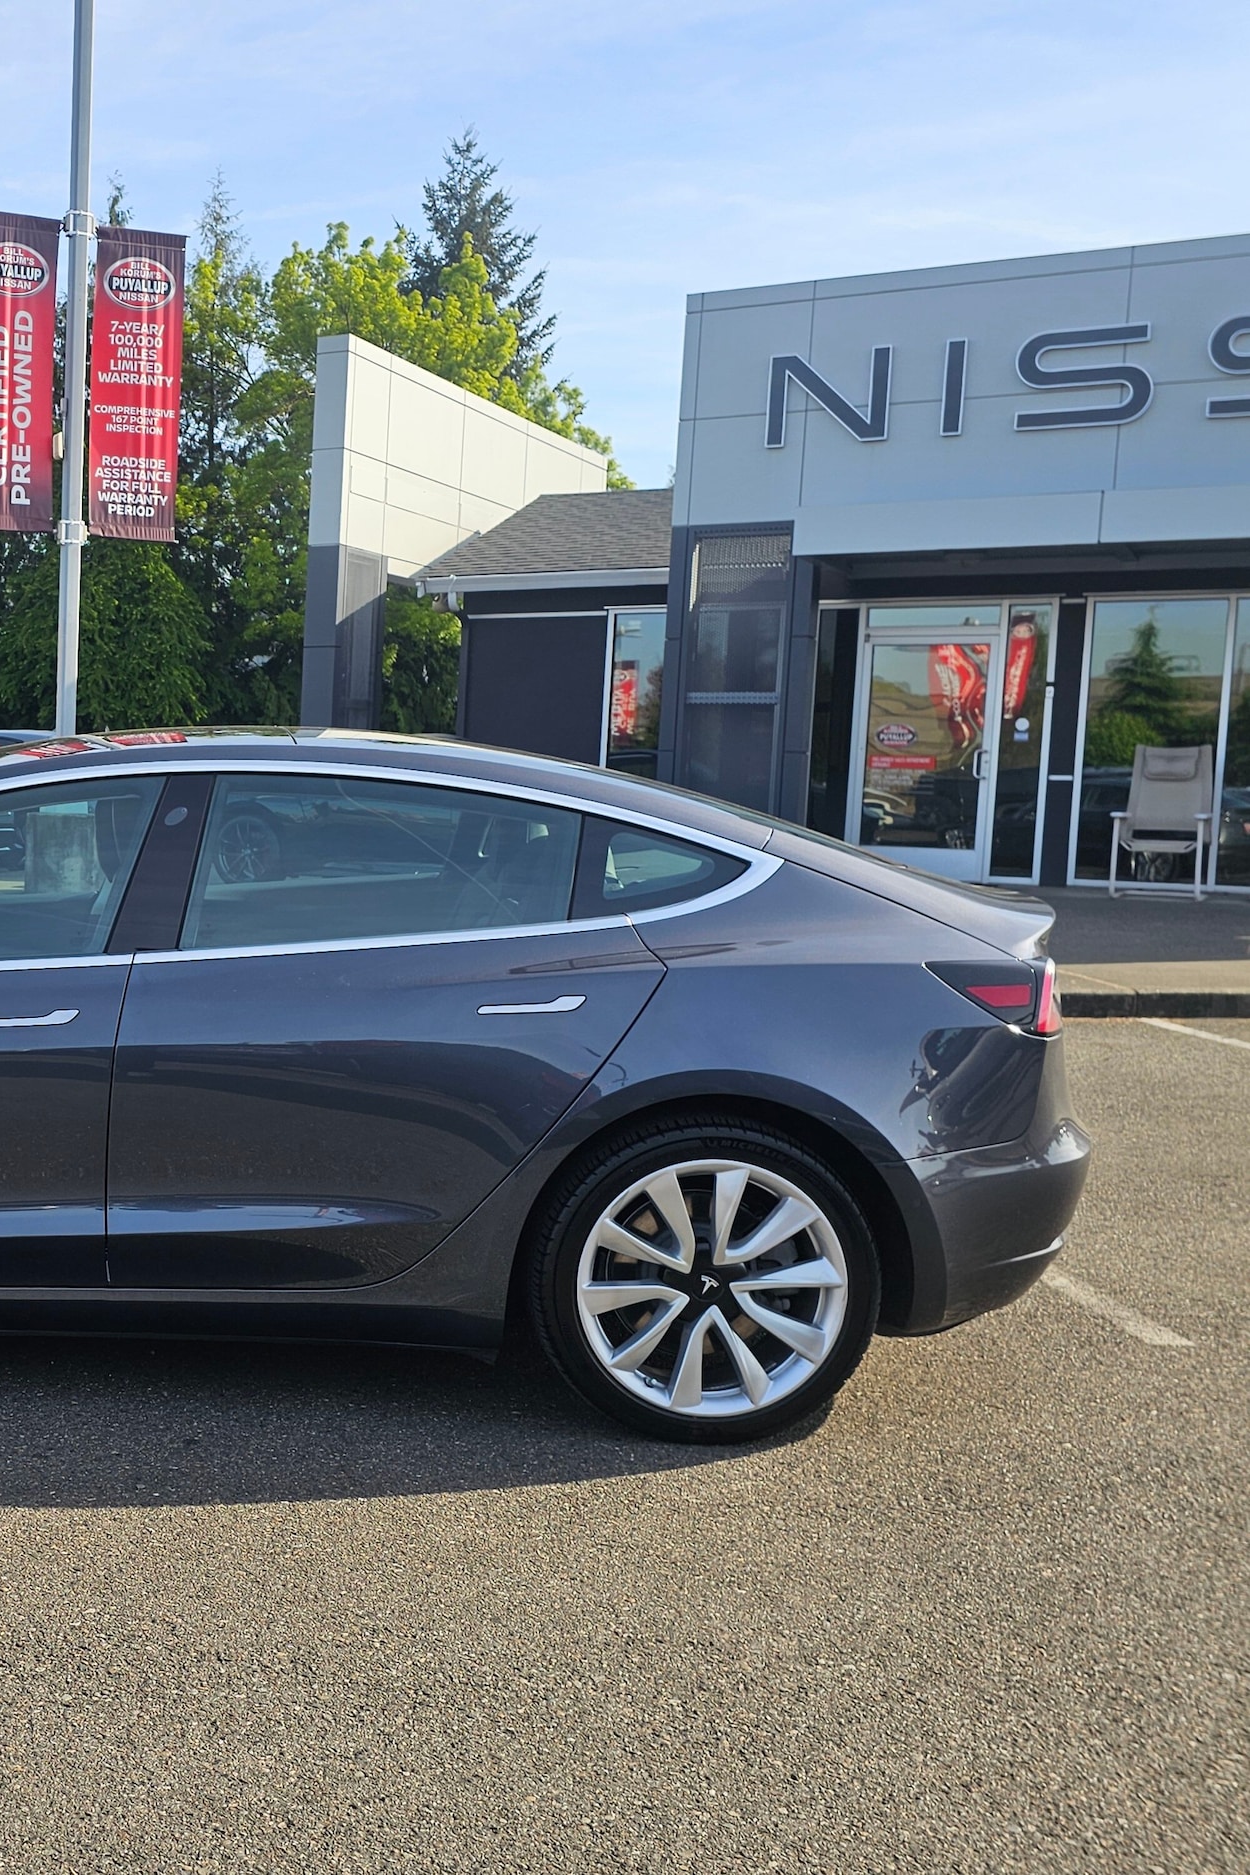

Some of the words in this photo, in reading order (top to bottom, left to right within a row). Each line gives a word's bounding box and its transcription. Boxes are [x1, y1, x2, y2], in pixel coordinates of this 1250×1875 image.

[3, 246, 24, 257] BILL
[130, 261, 150, 271] BILL
[120, 268, 162, 280] KORUM'S
[112, 277, 169, 295] PUYALLUP
[119, 292, 159, 303] NISSAN
[110, 320, 165, 336] 7-YEAR/
[108, 334, 163, 349] 100,000
[117, 347, 157, 360] MILES
[110, 359, 163, 374] LIMITED
[98, 371, 174, 388] WARRANTY
[10, 310, 34, 506] PRE-OWNED
[94, 404, 175, 419] COMPREHENSIVE
[111, 415, 128, 424] 167
[129, 416, 159, 426] POINT
[105, 423, 163, 435] INSPECTION
[101, 455, 166, 470] ROADSIDE
[94, 467, 172, 483] ASSISTANCE
[102, 479, 129, 491] FOR
[132, 481, 162, 494] FULL
[97, 490, 168, 506] WARRANTY
[108, 503, 155, 518] PERIOD
[720, 1139, 786, 1161] MICHELIN
